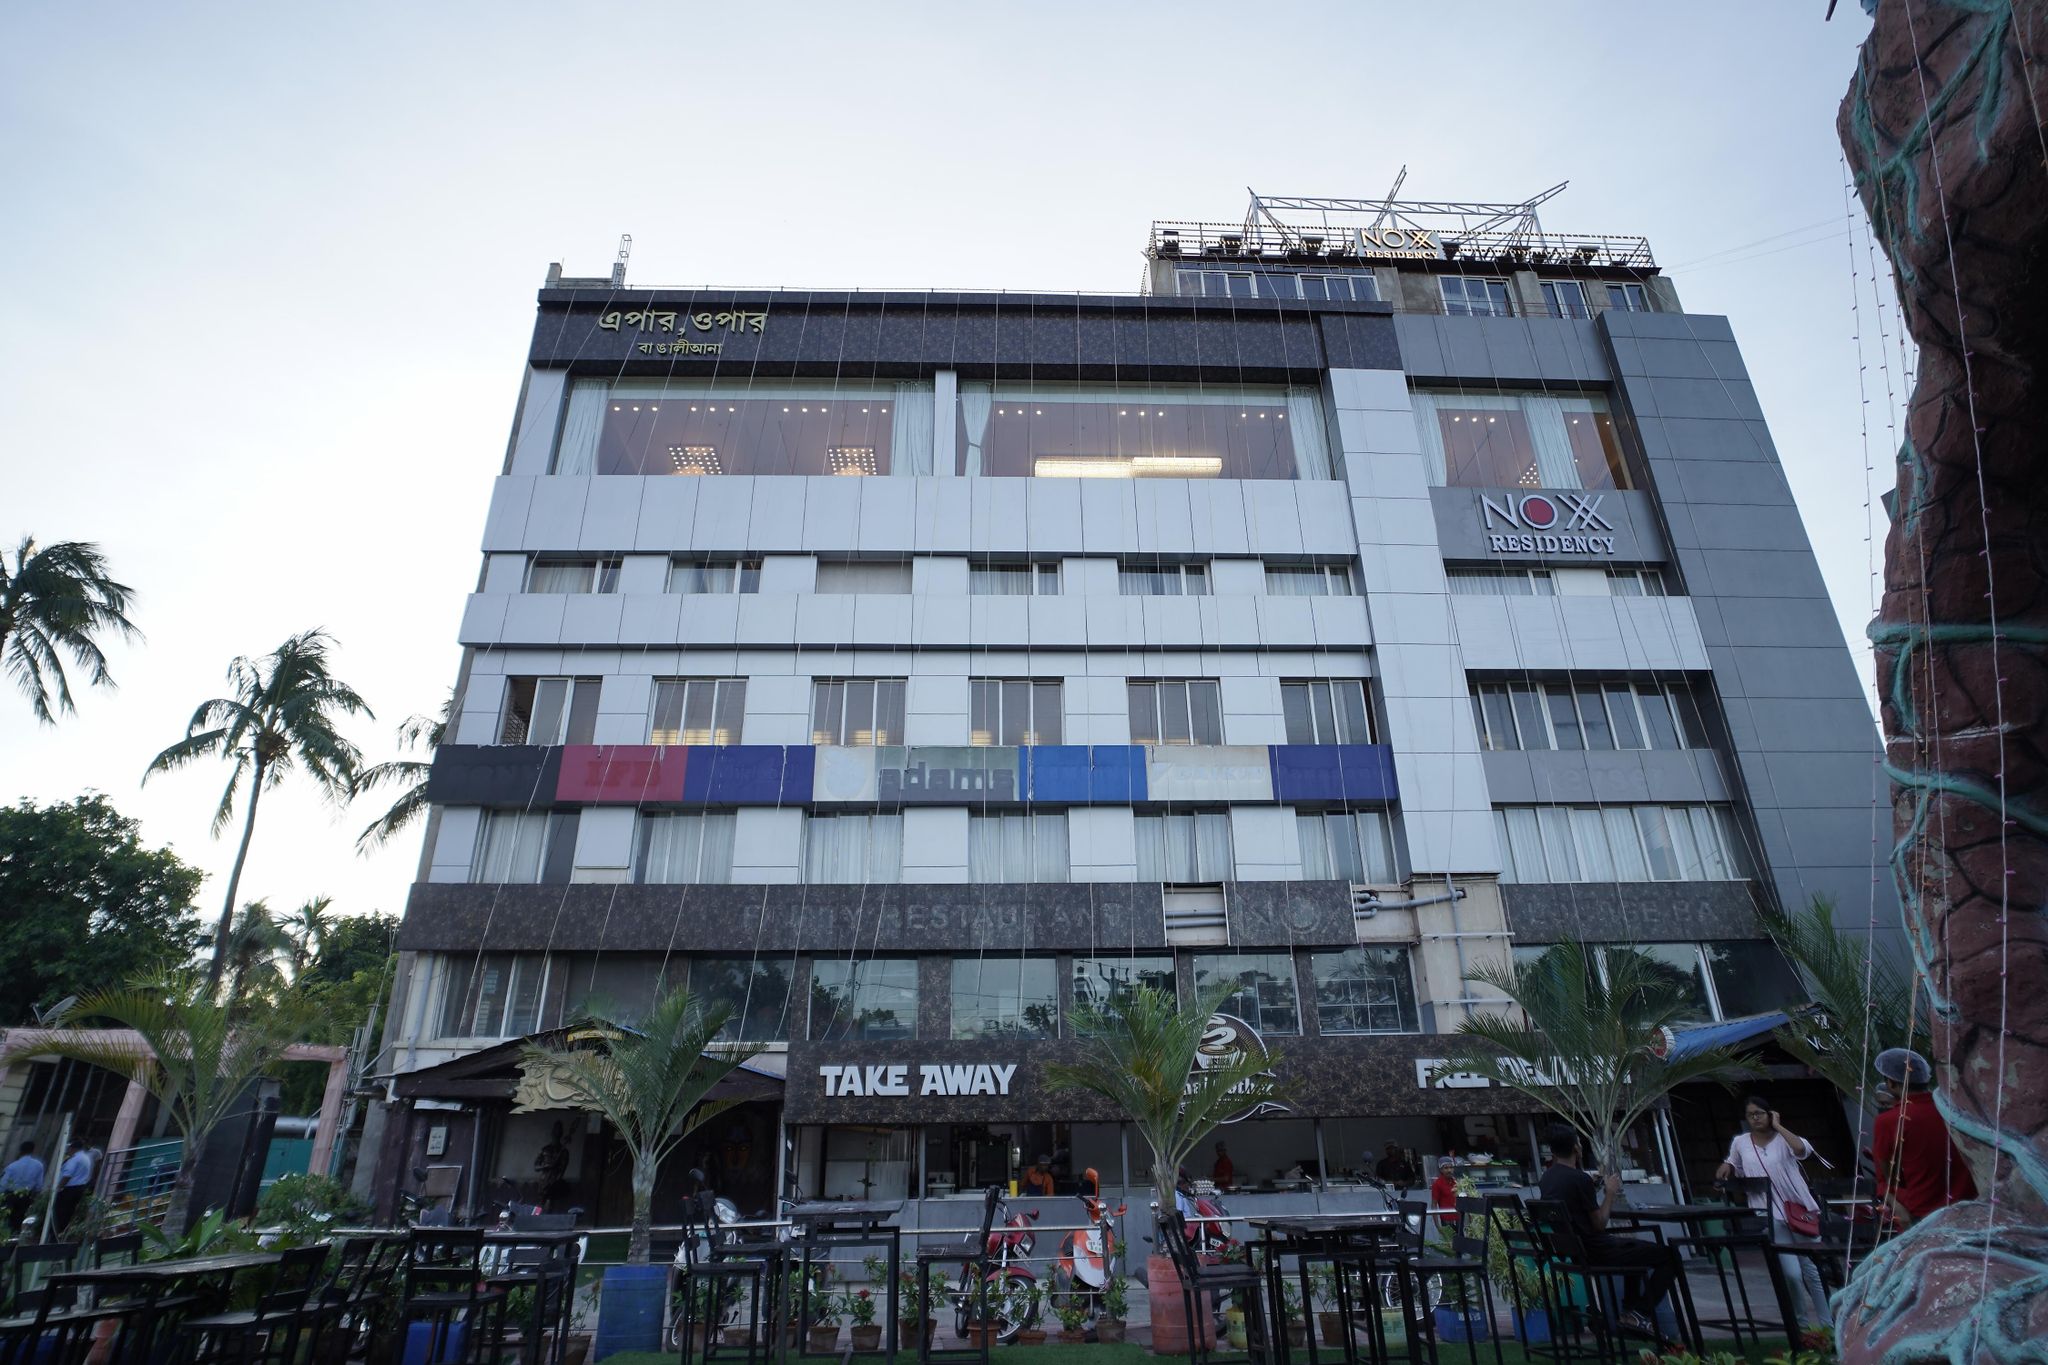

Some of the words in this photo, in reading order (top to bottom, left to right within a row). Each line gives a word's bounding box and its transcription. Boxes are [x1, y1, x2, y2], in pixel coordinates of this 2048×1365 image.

[1360, 229, 1437, 250] NOXX
[1365, 250, 1440, 259] RESIDENCY
[1480, 493, 1614, 531] NOXX
[1489, 534, 1615, 554] RESIDENCY
[819, 1065, 910, 1097] TAKE
[919, 1064, 1018, 1096] AWAY
